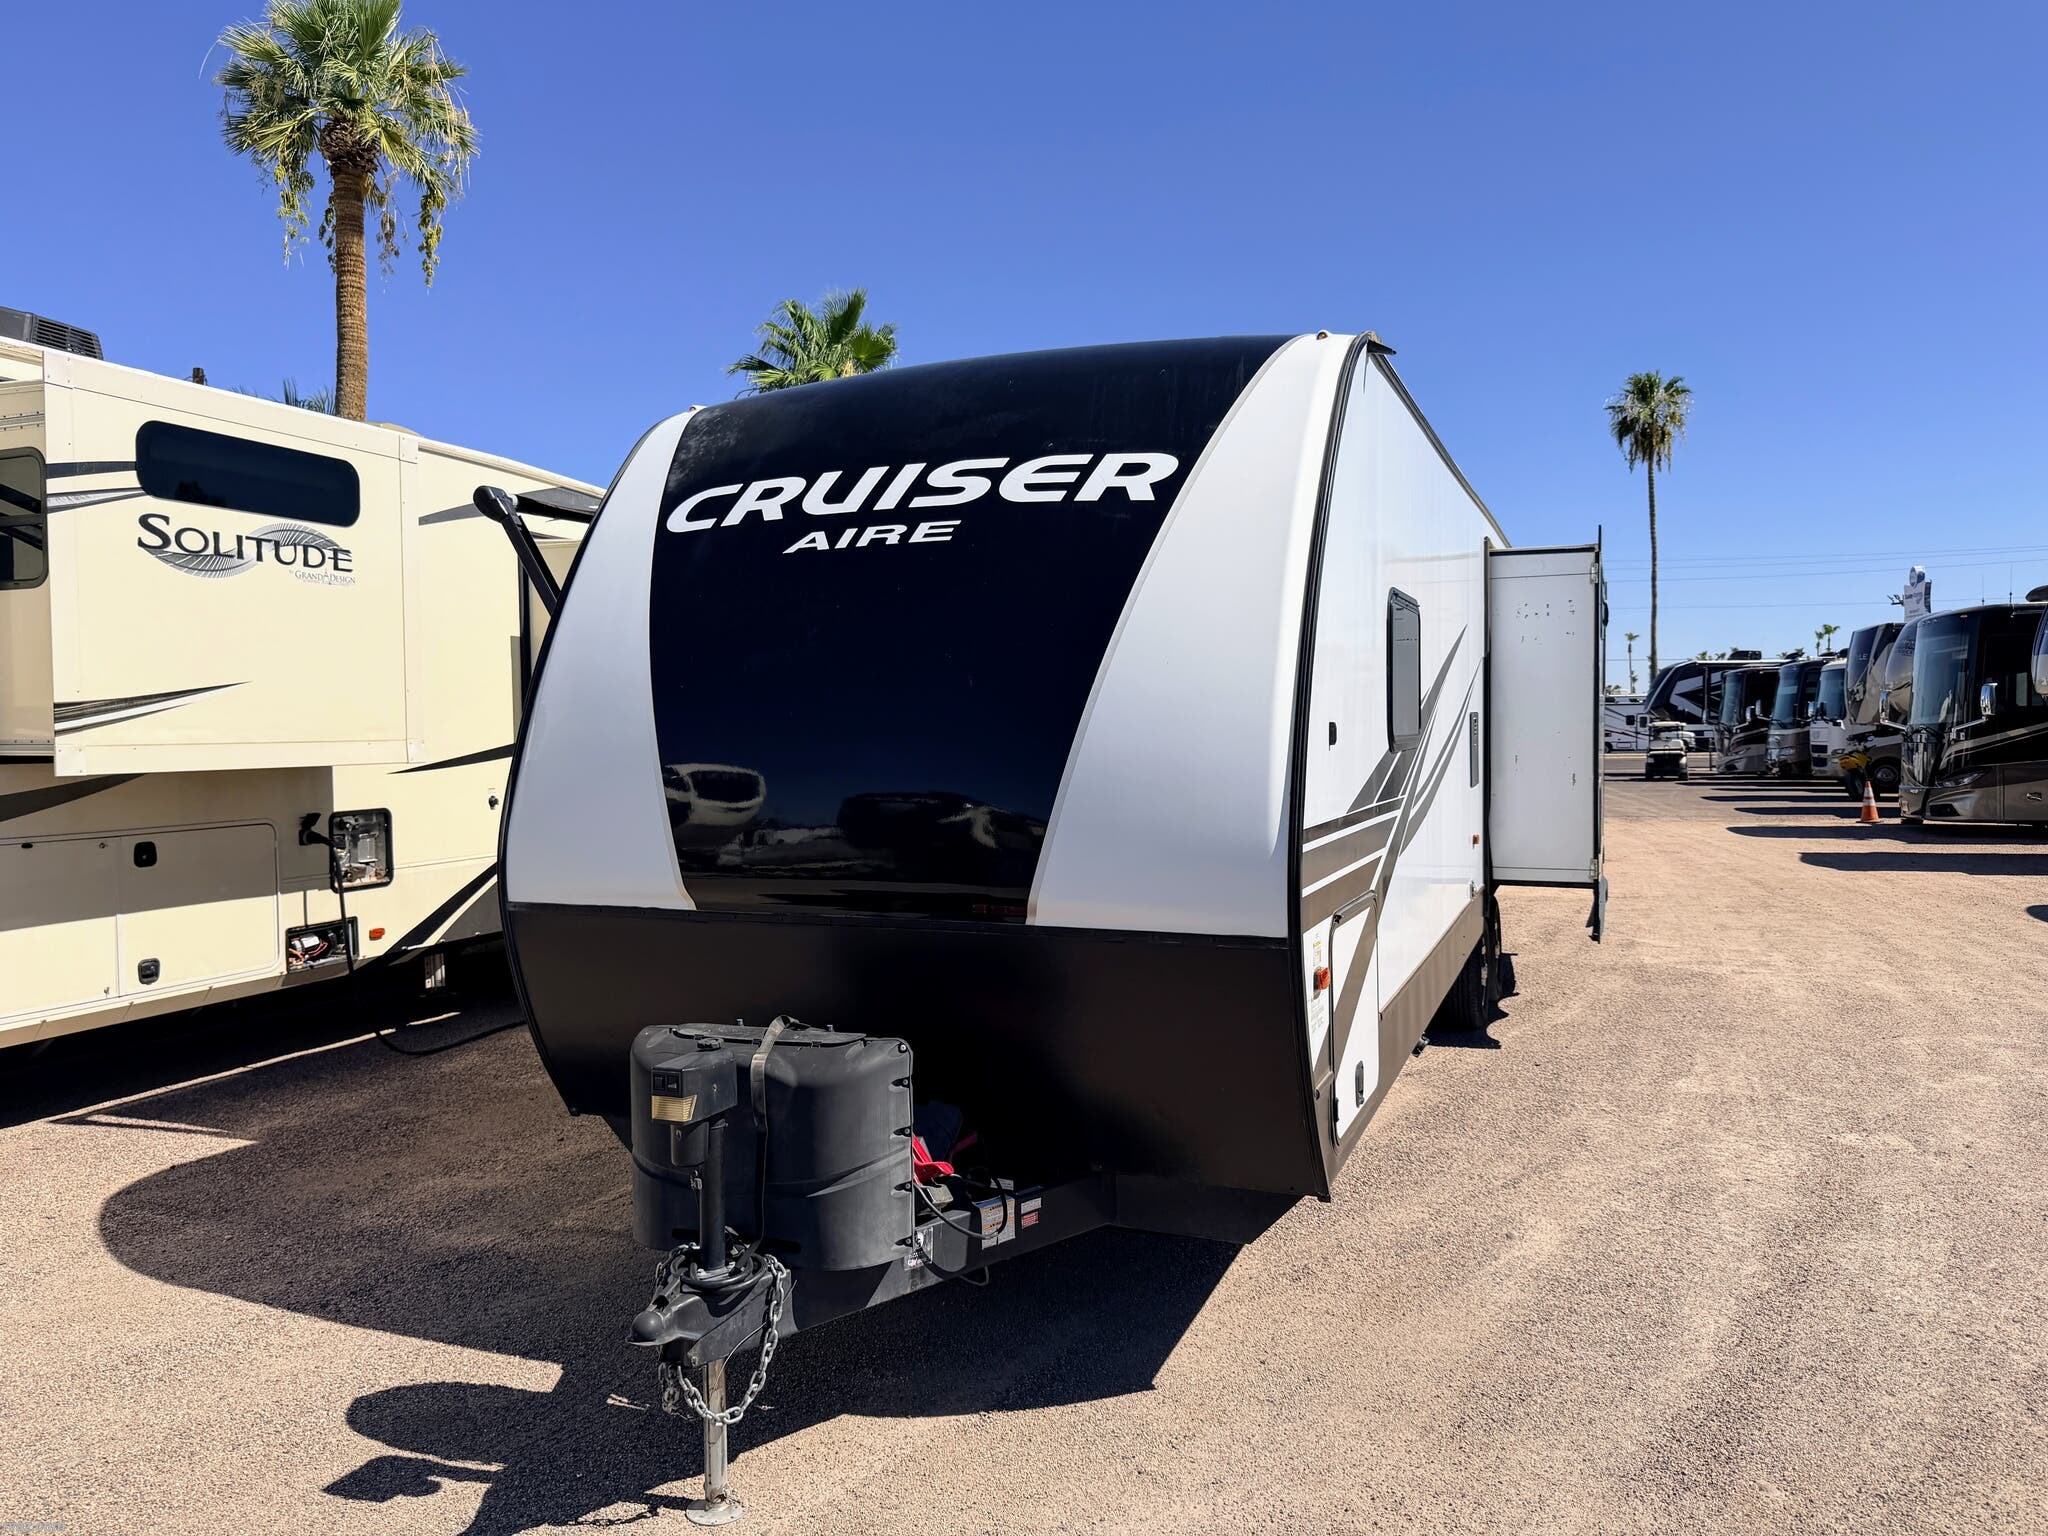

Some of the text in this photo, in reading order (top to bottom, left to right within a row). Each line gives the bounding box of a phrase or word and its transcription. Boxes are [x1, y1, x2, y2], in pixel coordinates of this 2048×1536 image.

[666, 453, 1179, 533] CRUISER
[137, 513, 353, 573] SOLITUDE
[782, 520, 961, 554] AIRE
[295, 570, 323, 581] GRAND
[330, 573, 356, 584] DESIGN
